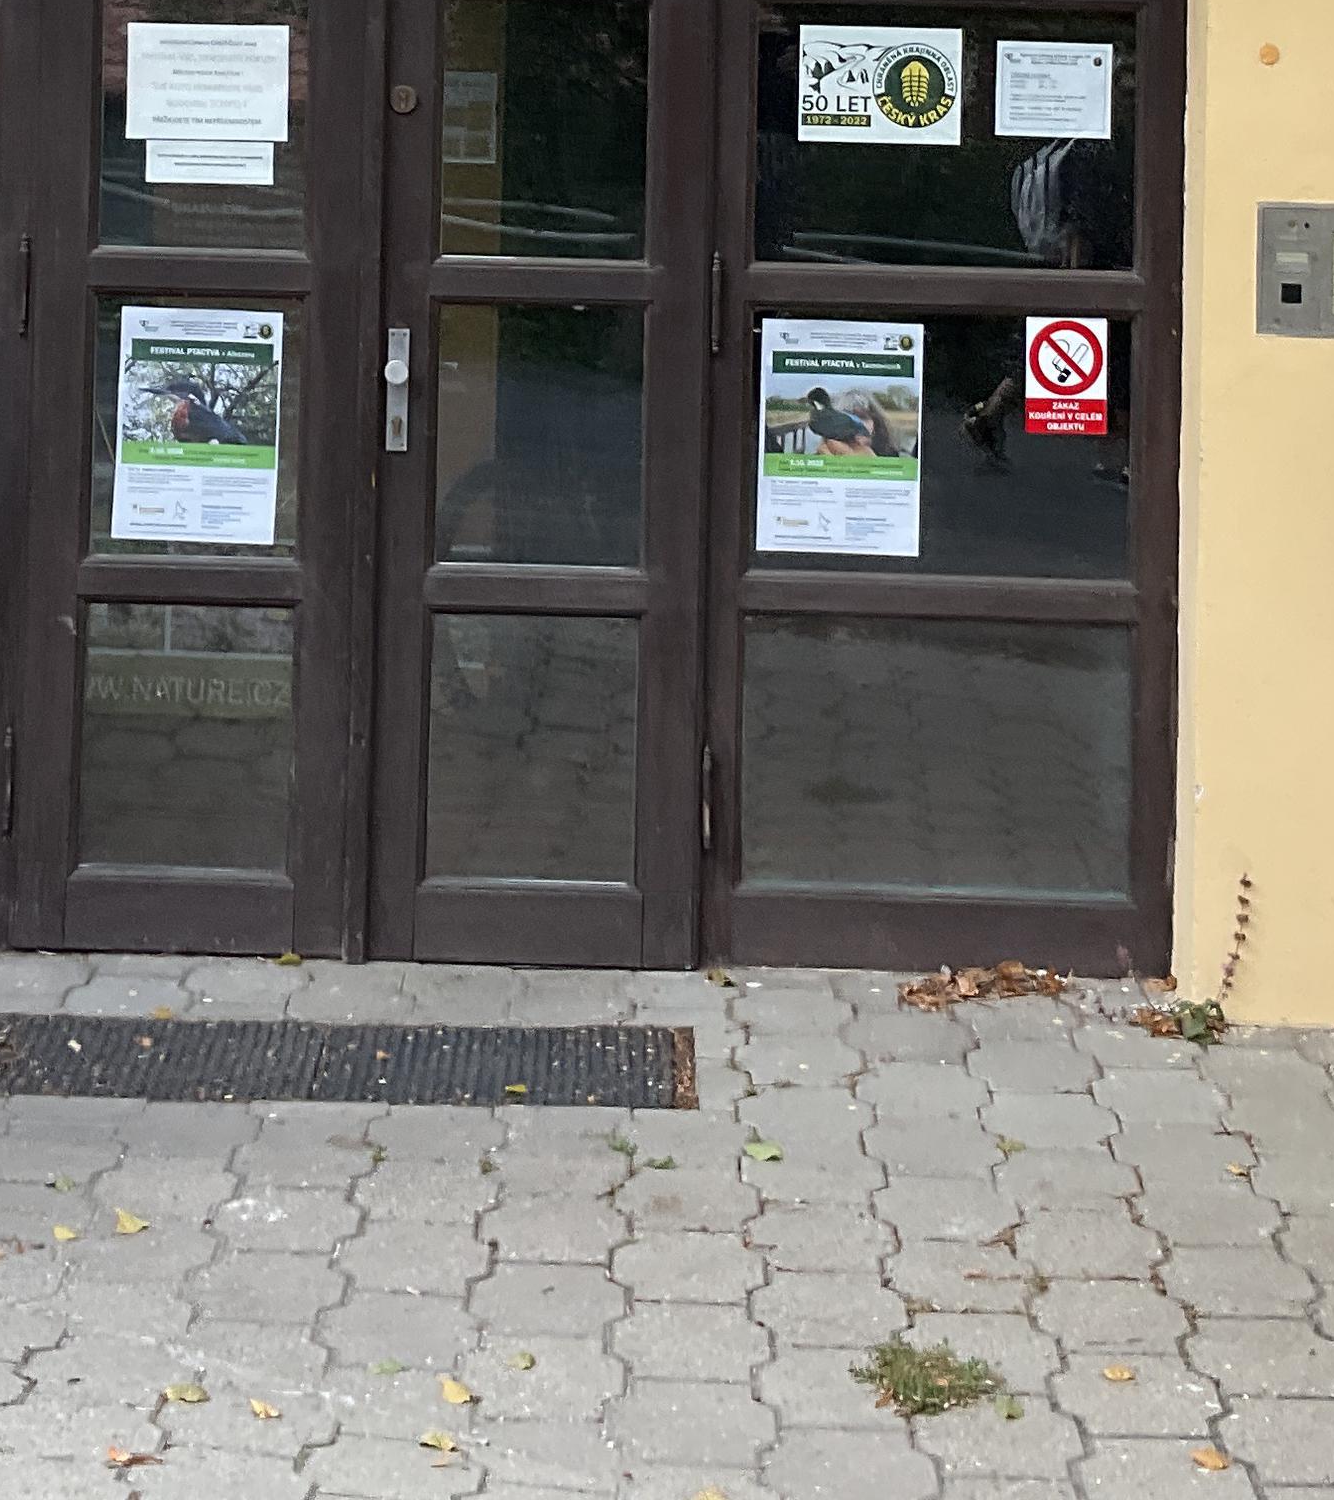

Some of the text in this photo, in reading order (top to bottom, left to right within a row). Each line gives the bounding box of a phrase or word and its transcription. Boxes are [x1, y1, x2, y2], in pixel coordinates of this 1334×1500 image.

[940, 60, 955, 92] OBLAST
[801, 95, 872, 113] 50 LET
[877, 95, 953, 127] ČESKÝ KRAS
[805, 115, 832, 125] 1972
[840, 115, 868, 126] 2022
[784, 357, 820, 368] FESTIVAL
[1052, 401, 1080, 410] ZÁKAZ
[1028, 410, 1103, 421] KOUŘENÍ V CELÉM
[1046, 422, 1085, 431] OBJEKTU
